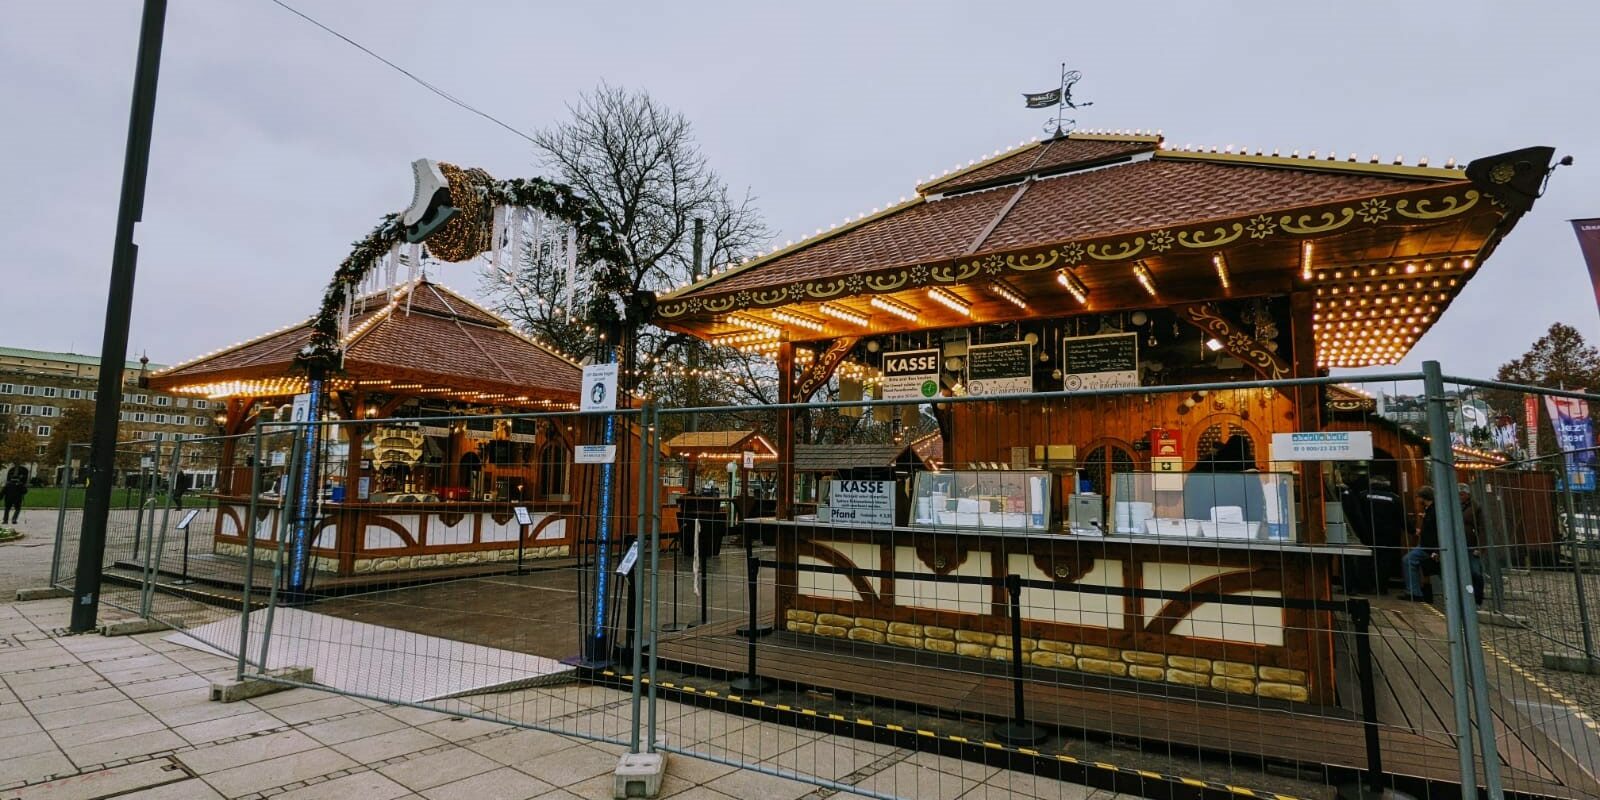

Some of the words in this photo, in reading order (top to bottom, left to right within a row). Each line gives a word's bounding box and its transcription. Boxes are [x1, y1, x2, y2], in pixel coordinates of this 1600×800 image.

[887, 356, 936, 372] KASSE
[841, 481, 883, 493] KASSE
[831, 509, 856, 519] Pfand
